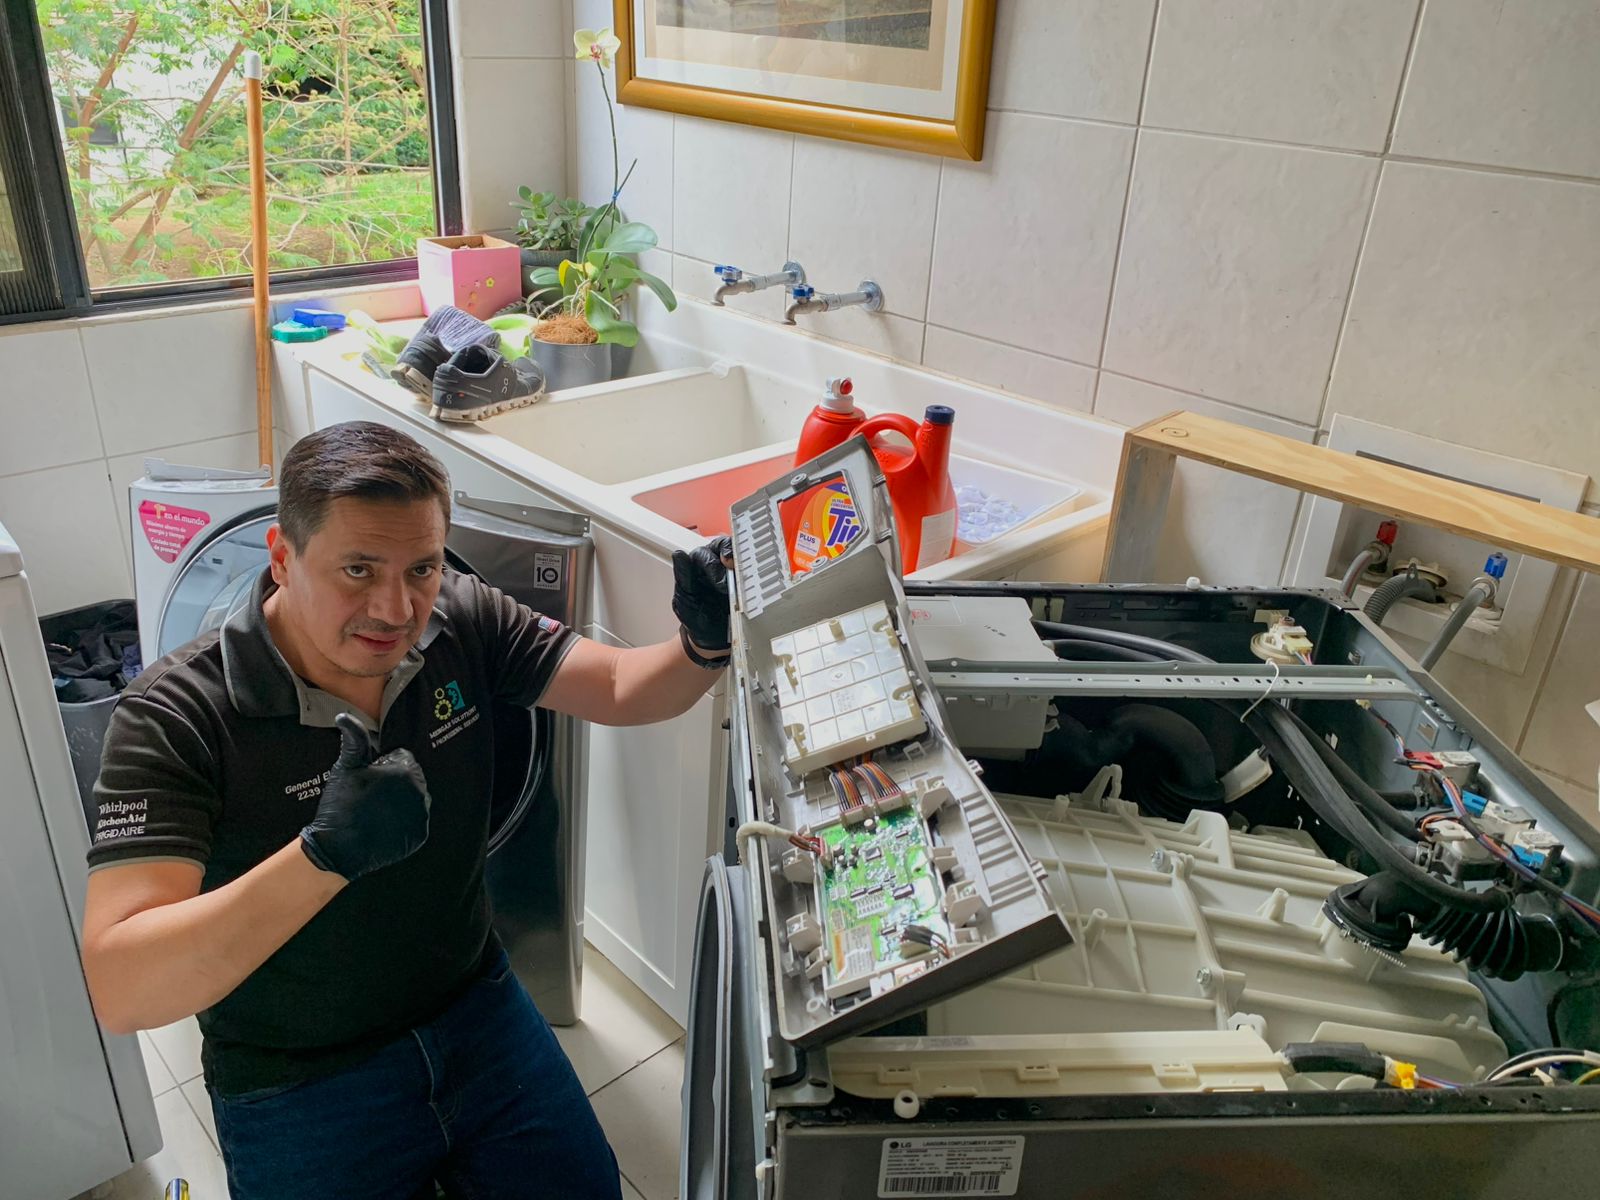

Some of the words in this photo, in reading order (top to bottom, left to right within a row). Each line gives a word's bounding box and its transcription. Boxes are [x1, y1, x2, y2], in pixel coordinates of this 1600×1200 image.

[181, 514, 205, 526] mundo
[799, 533, 816, 544] PLUS
[536, 566, 559, 584] 10
[285, 774, 321, 795] General
[297, 786, 321, 801] 2239
[99, 798, 148, 815] Whirlpool
